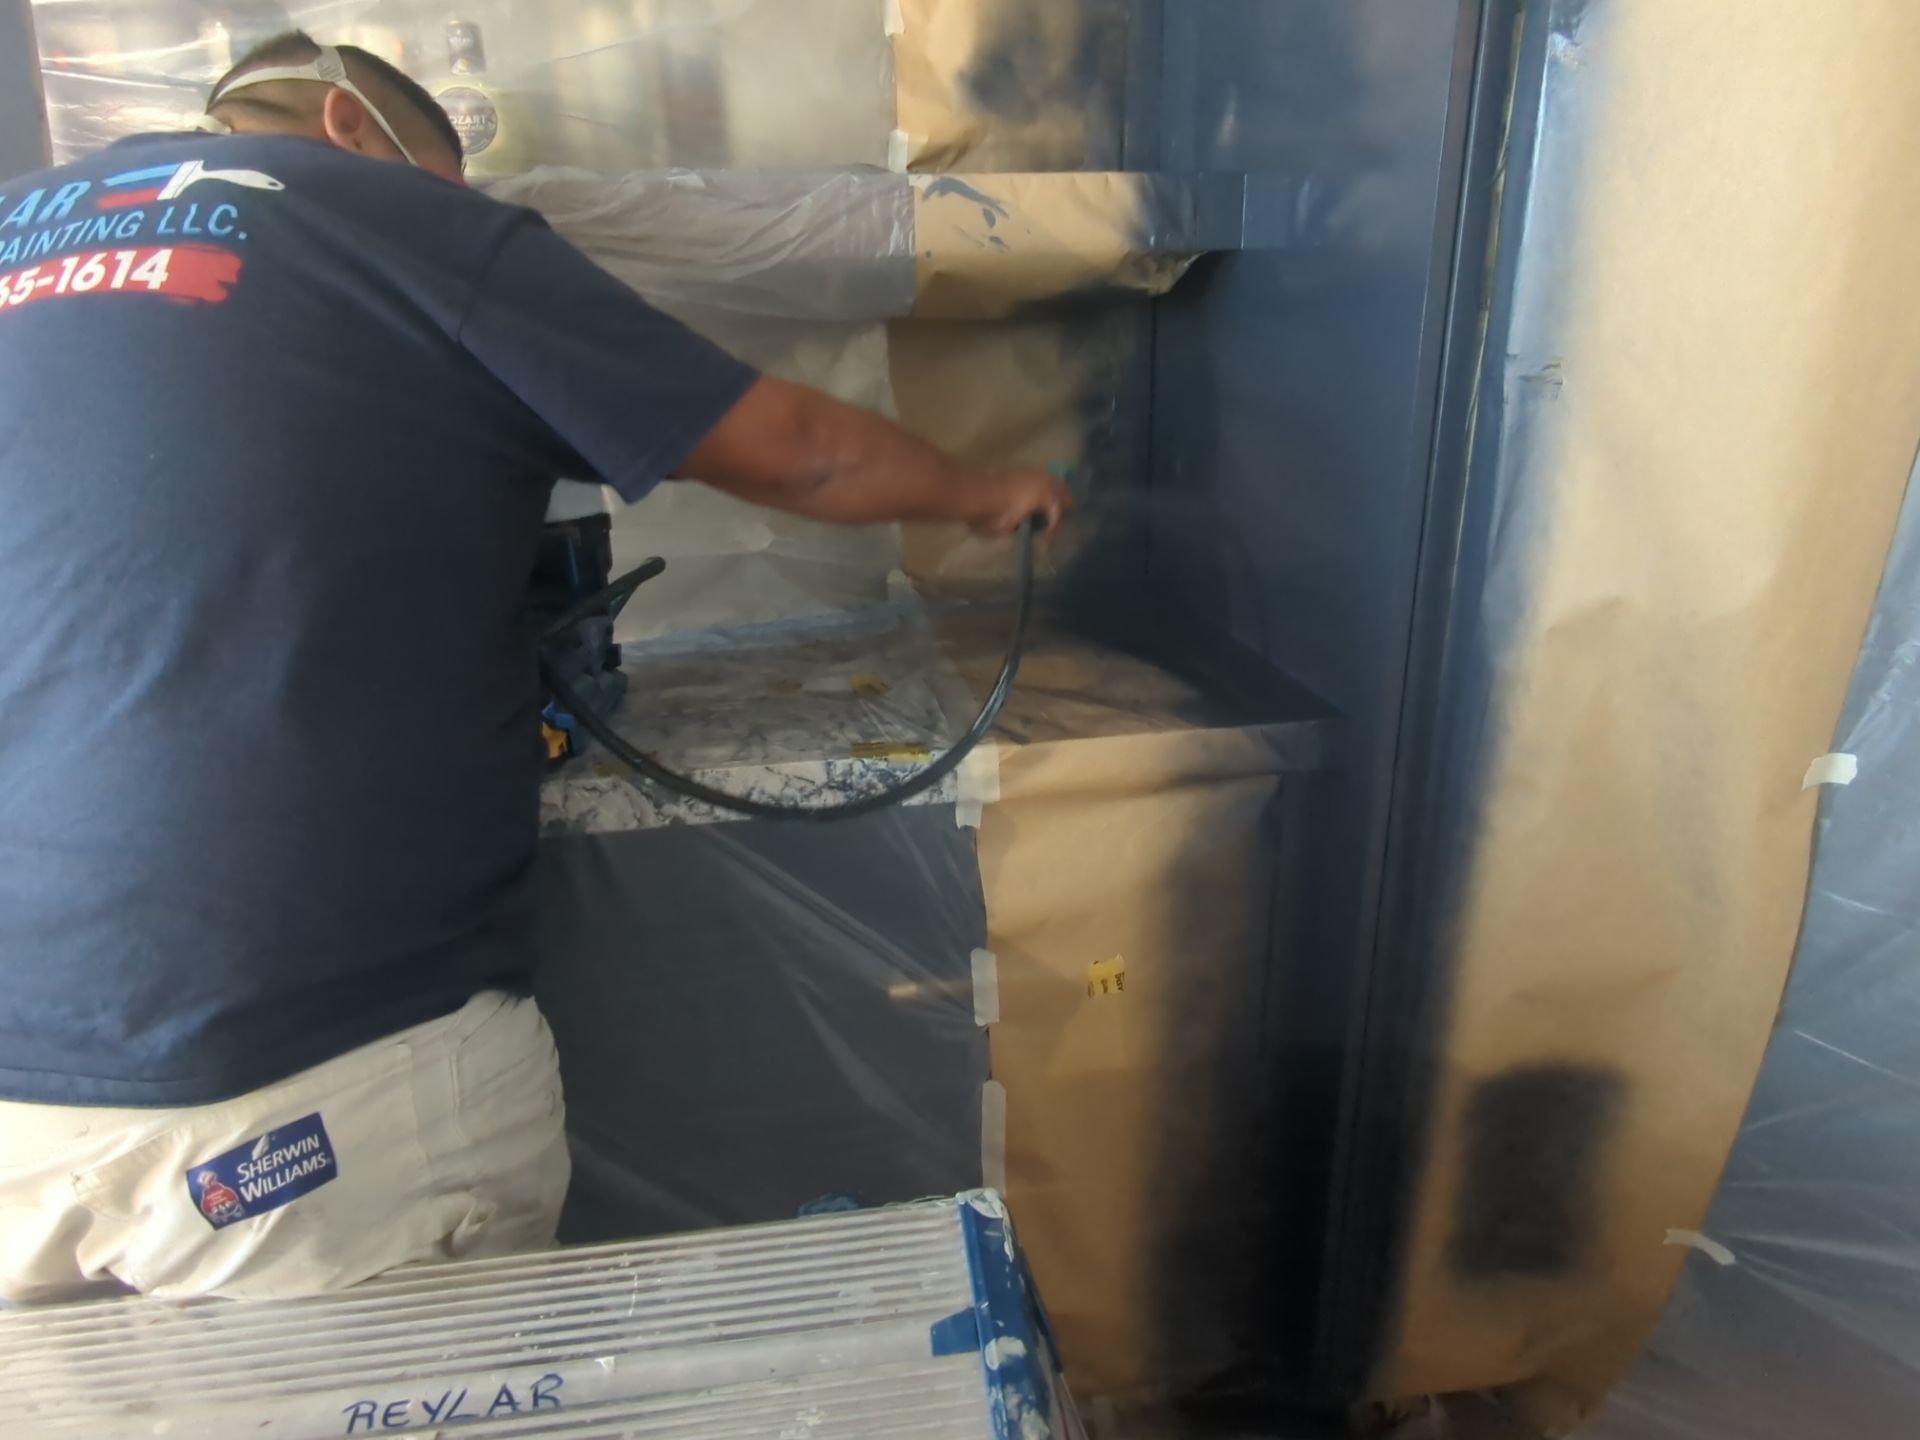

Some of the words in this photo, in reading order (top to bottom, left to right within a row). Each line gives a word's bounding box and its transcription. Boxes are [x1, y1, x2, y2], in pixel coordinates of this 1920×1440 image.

[448, 114, 486, 125] OZART
[0, 181, 91, 228] AR
[157, 203, 247, 240] LLC.
[237, 1134, 320, 1184] SHERWIN
[239, 1152, 327, 1202] WILLIAMS
[343, 1373, 564, 1434] REYLAR
